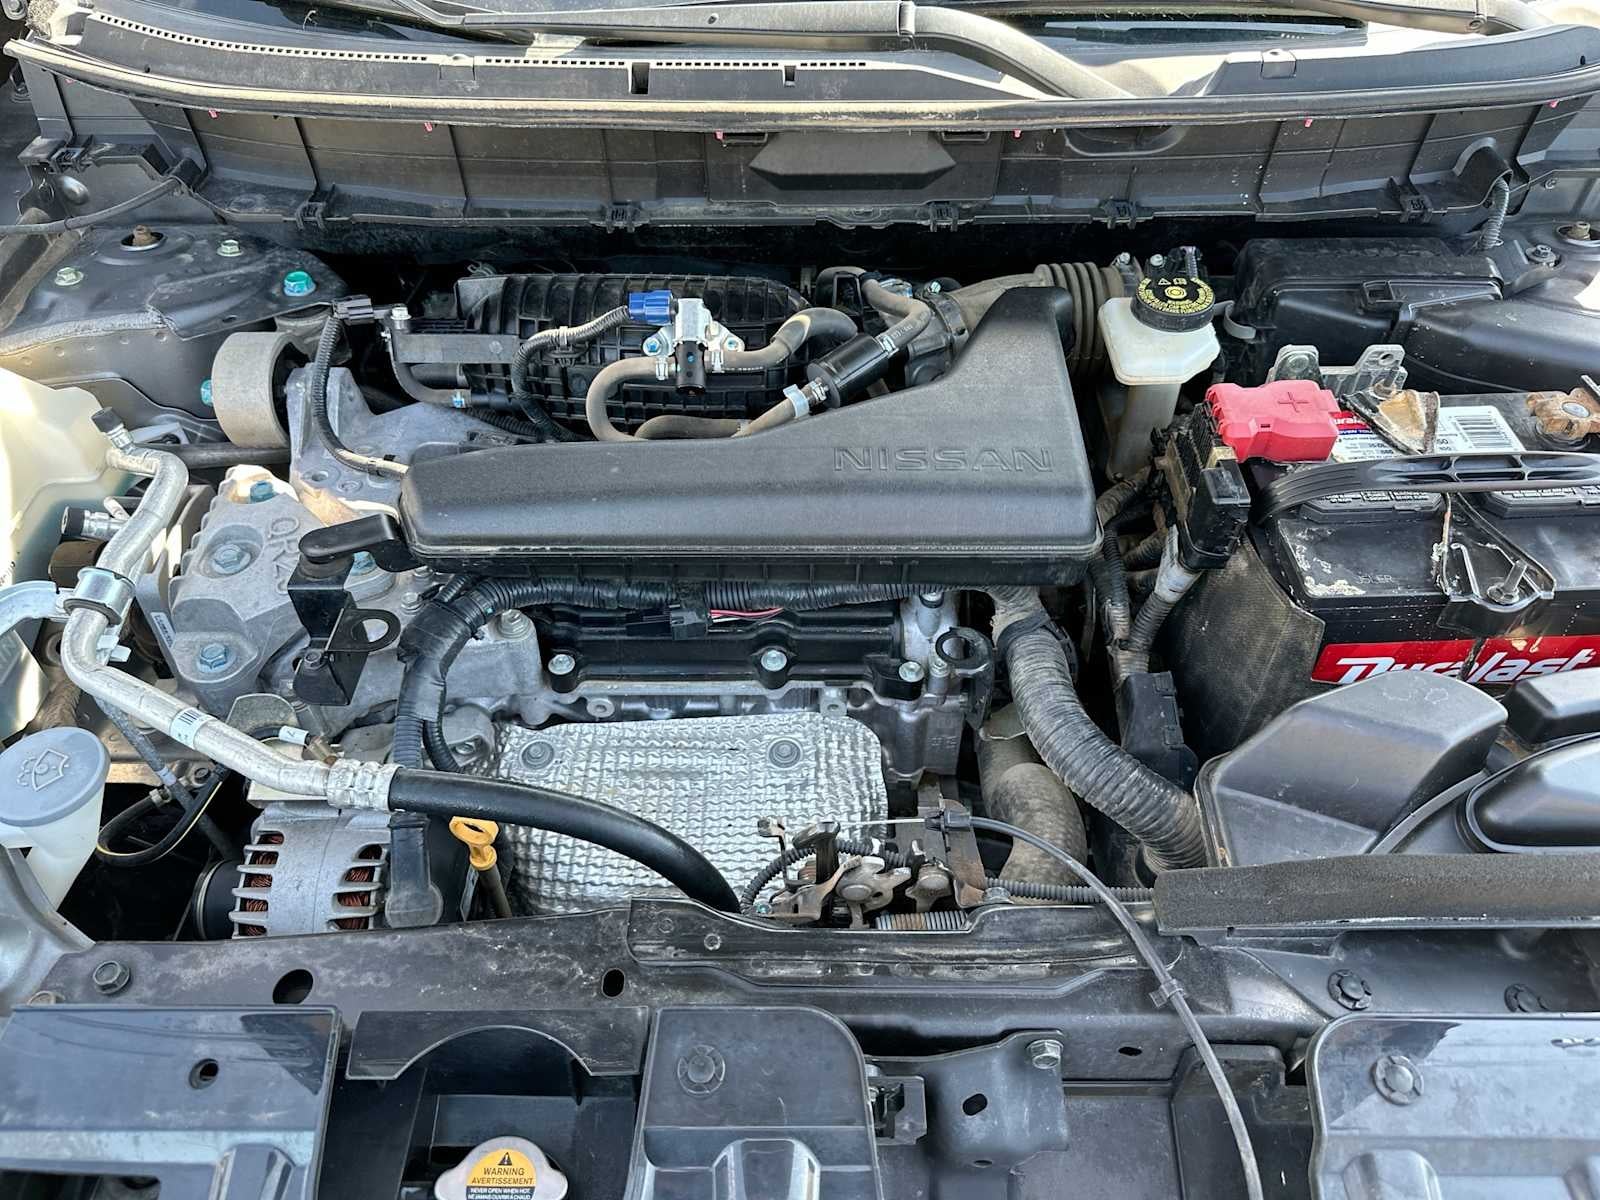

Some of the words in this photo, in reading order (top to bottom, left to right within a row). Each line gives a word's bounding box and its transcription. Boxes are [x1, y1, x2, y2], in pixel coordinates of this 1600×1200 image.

[833, 446, 1053, 472] NISSAN
[483, 1167, 525, 1176] WARNING
[471, 1177, 533, 1185] AVERTISSEMENT
